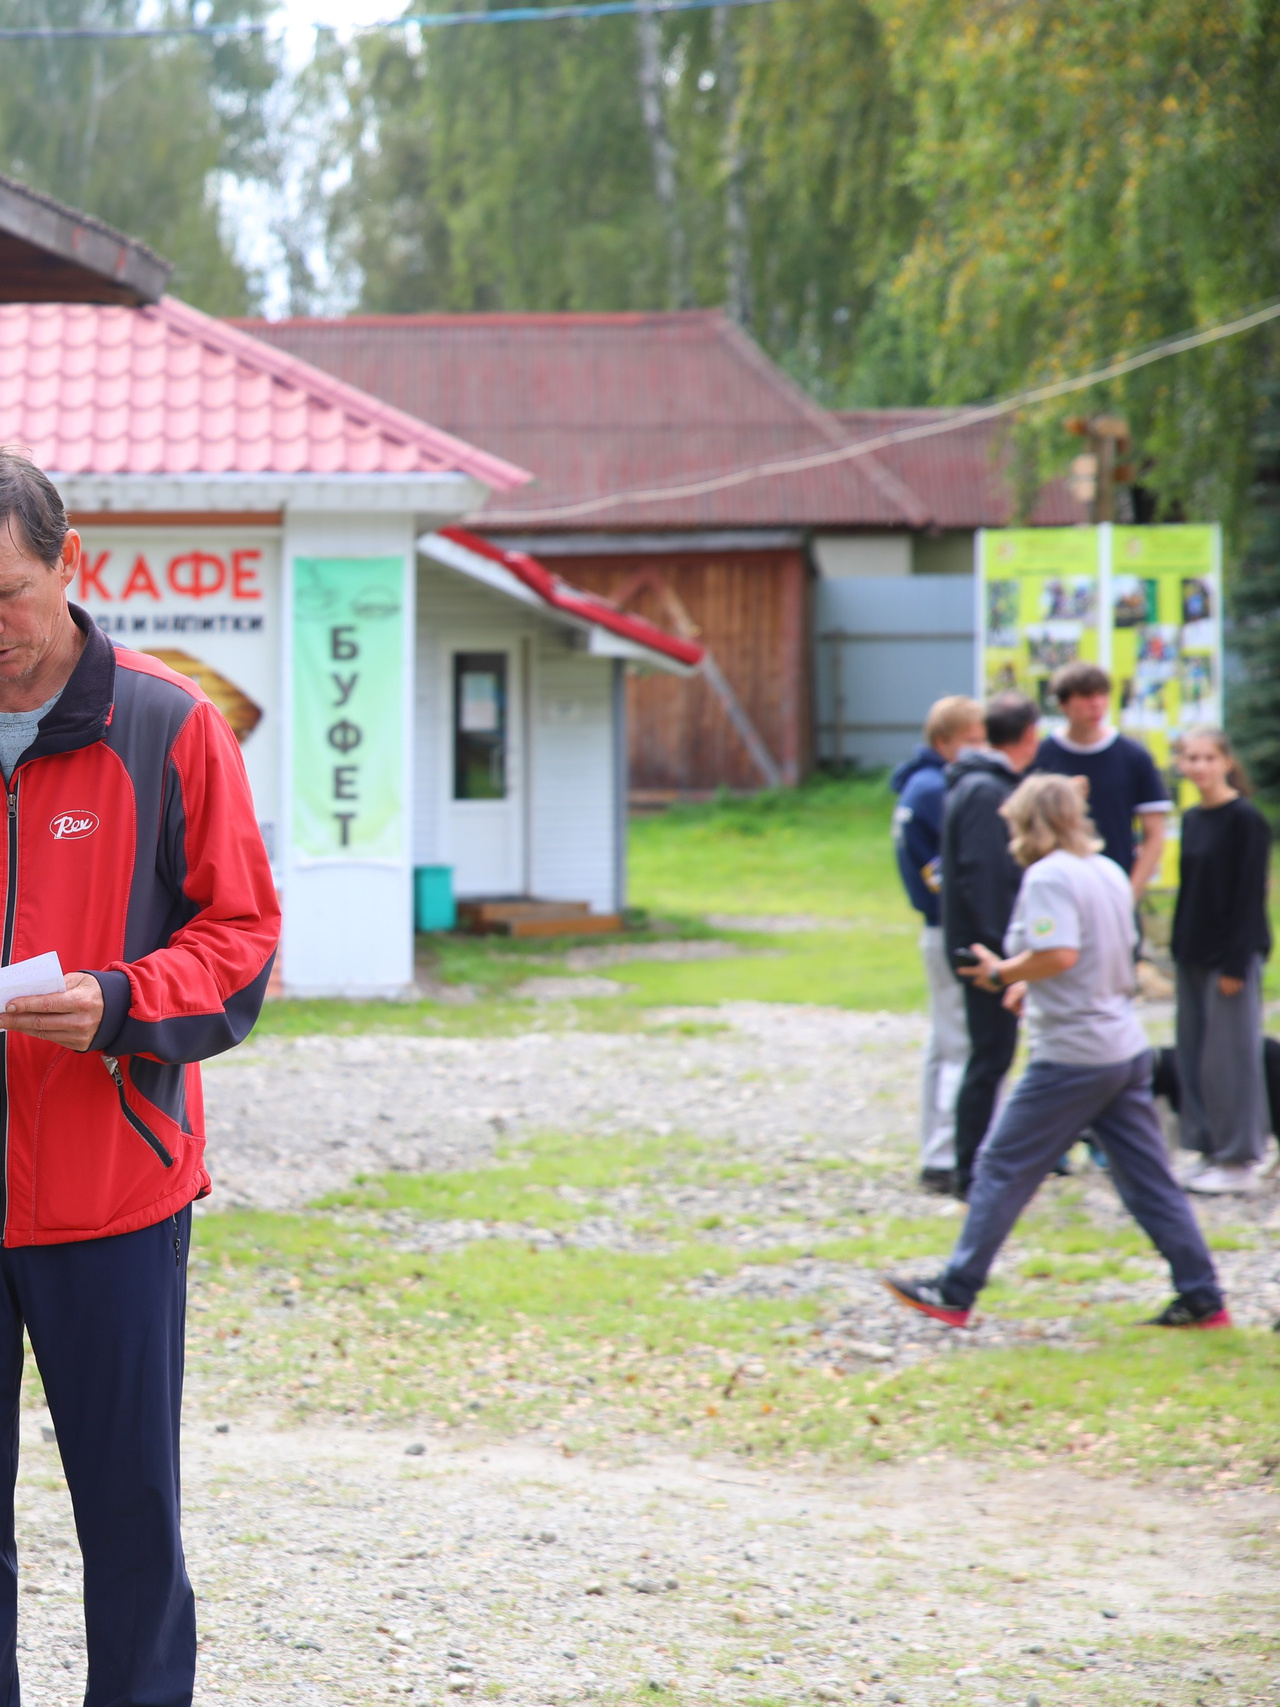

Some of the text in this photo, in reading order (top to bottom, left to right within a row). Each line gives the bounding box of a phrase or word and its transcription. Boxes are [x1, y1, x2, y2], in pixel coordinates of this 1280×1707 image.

[79, 549, 263, 602] КАФЕ
[153, 614, 264, 634] НАПИТКИ
[328, 625, 363, 848] БУФЕТ
[53, 816, 93, 839] Rex
